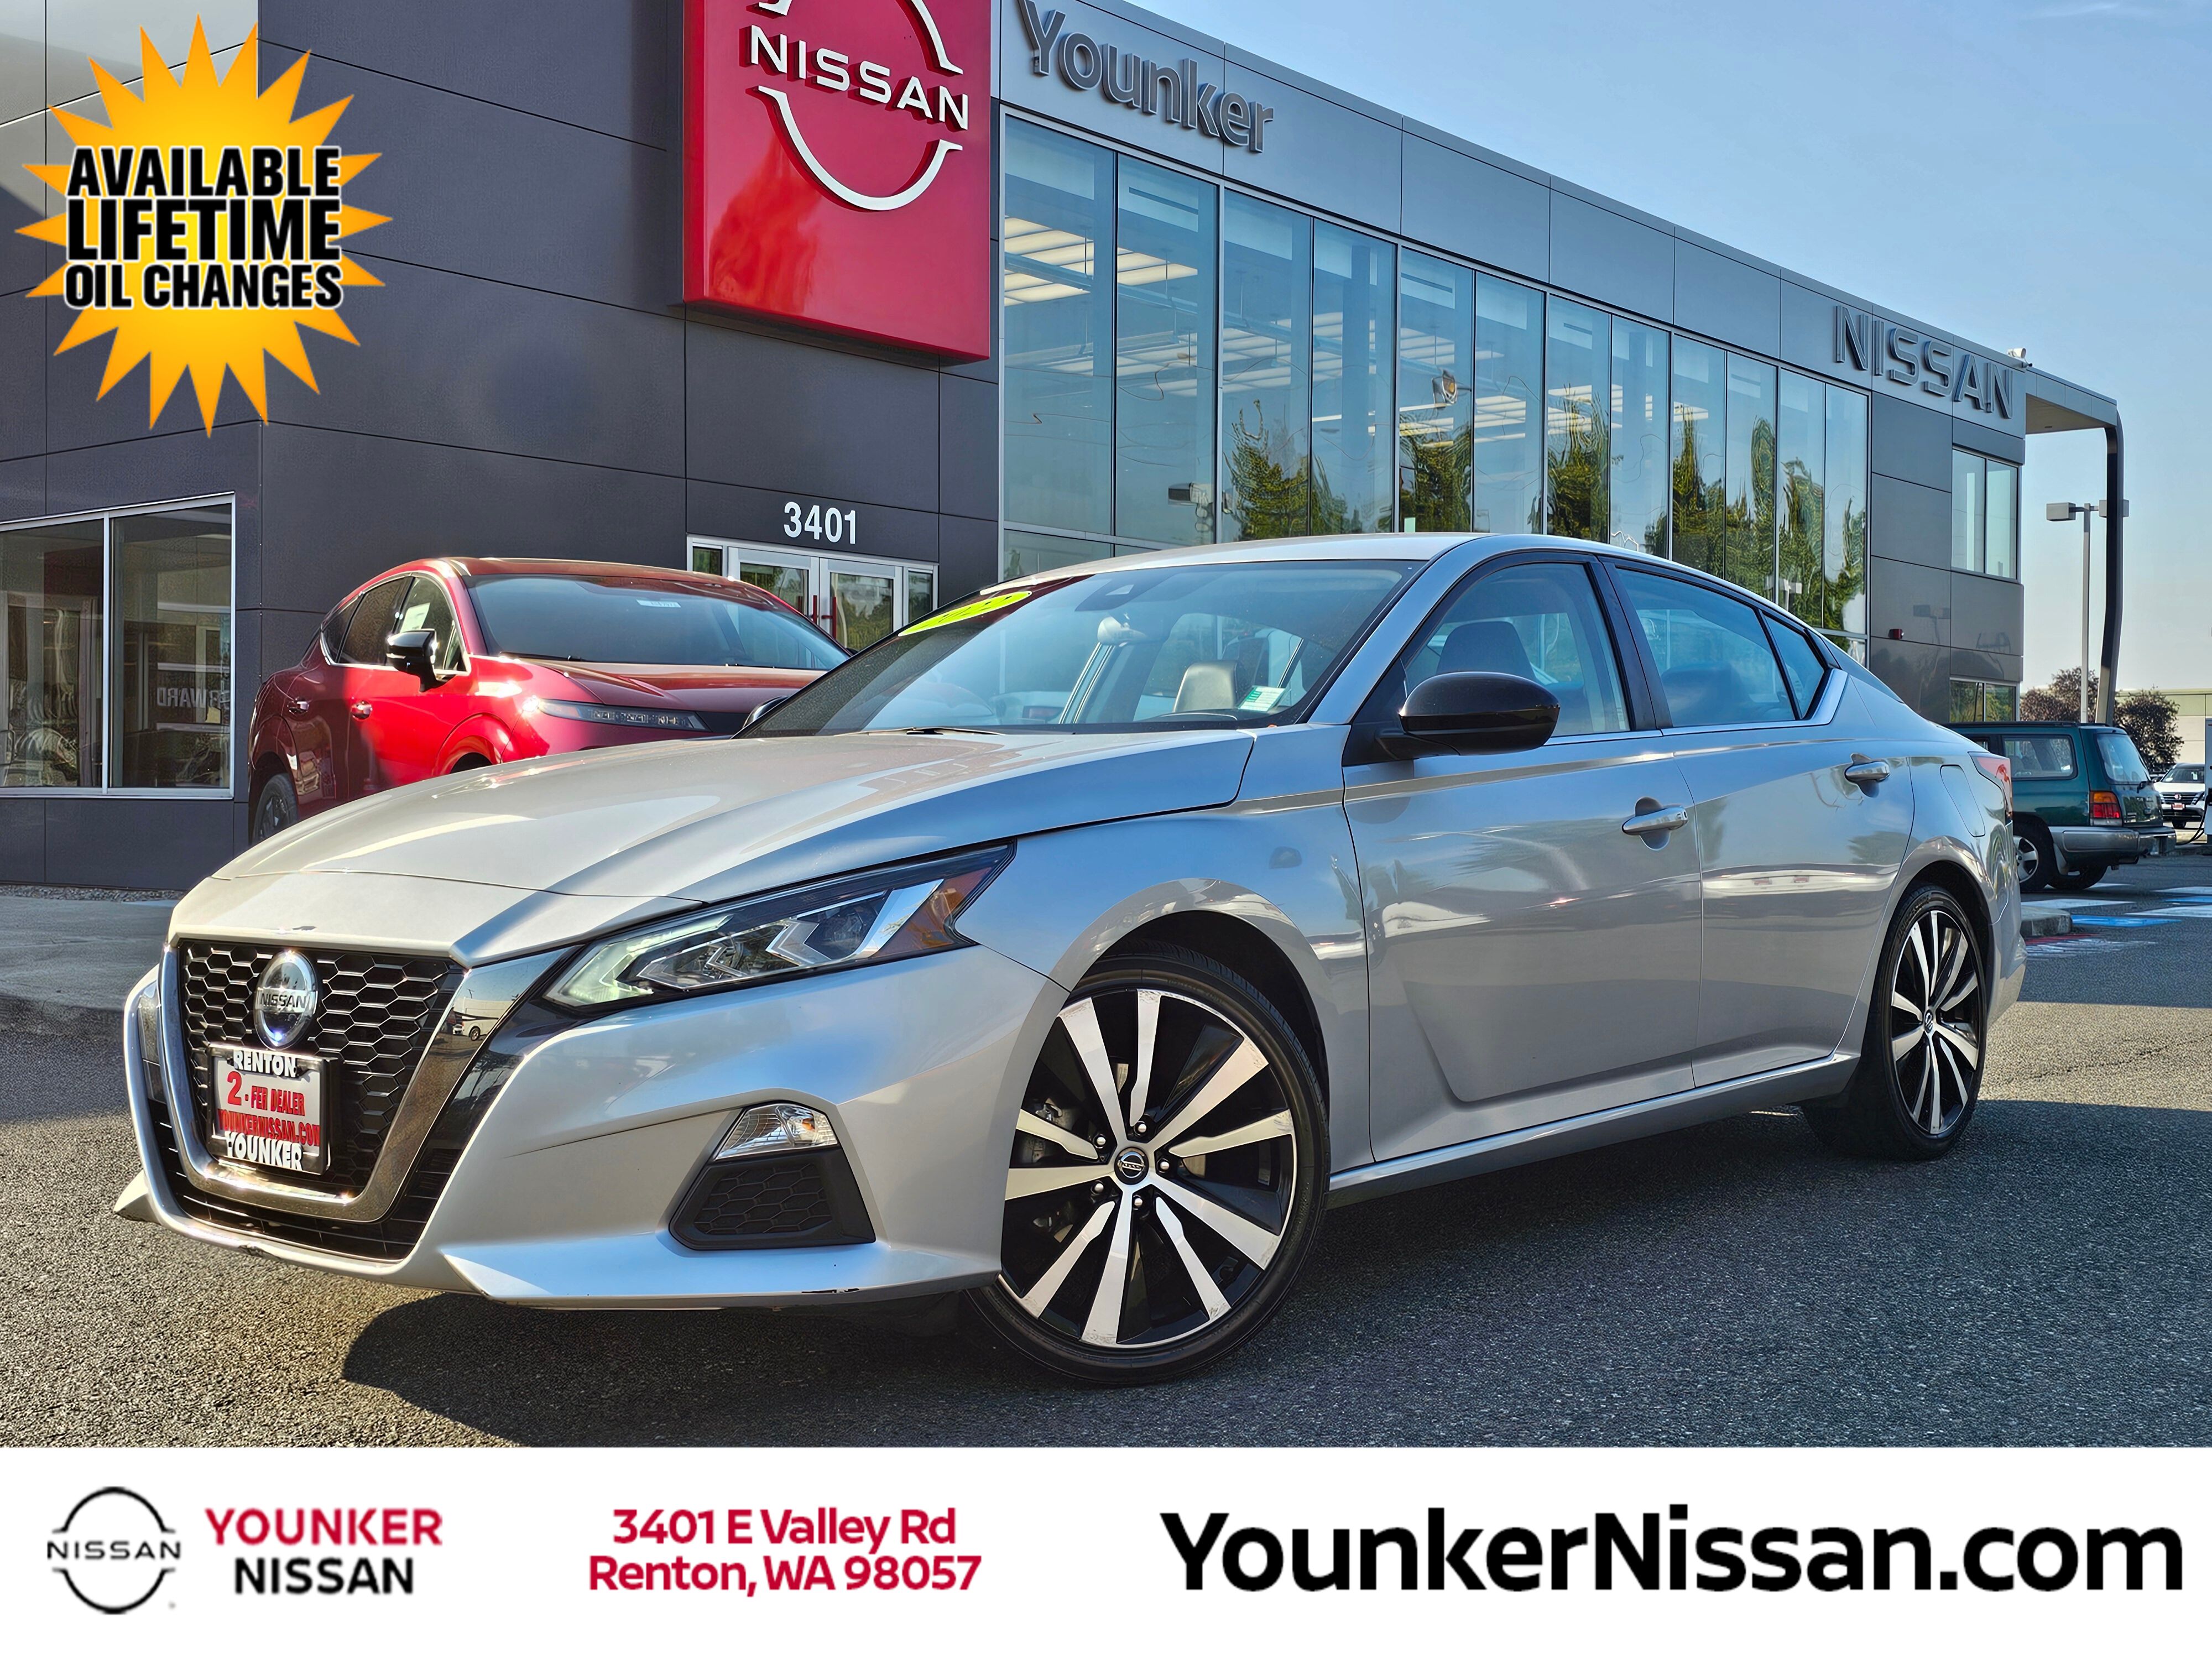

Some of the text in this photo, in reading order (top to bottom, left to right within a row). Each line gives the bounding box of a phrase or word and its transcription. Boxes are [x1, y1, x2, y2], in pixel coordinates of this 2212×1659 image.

[750, 24, 968, 131] NISSAN
[1018, 0, 1274, 153] Younker
[1836, 305, 2013, 419] NISSAN
[784, 502, 856, 544] 3401
[260, 993, 306, 1009] NISSAN
[233, 1050, 297, 1077] RENTON
[270, 1089, 305, 1117] DEALER
[225, 1131, 302, 1171] YOUNKER
